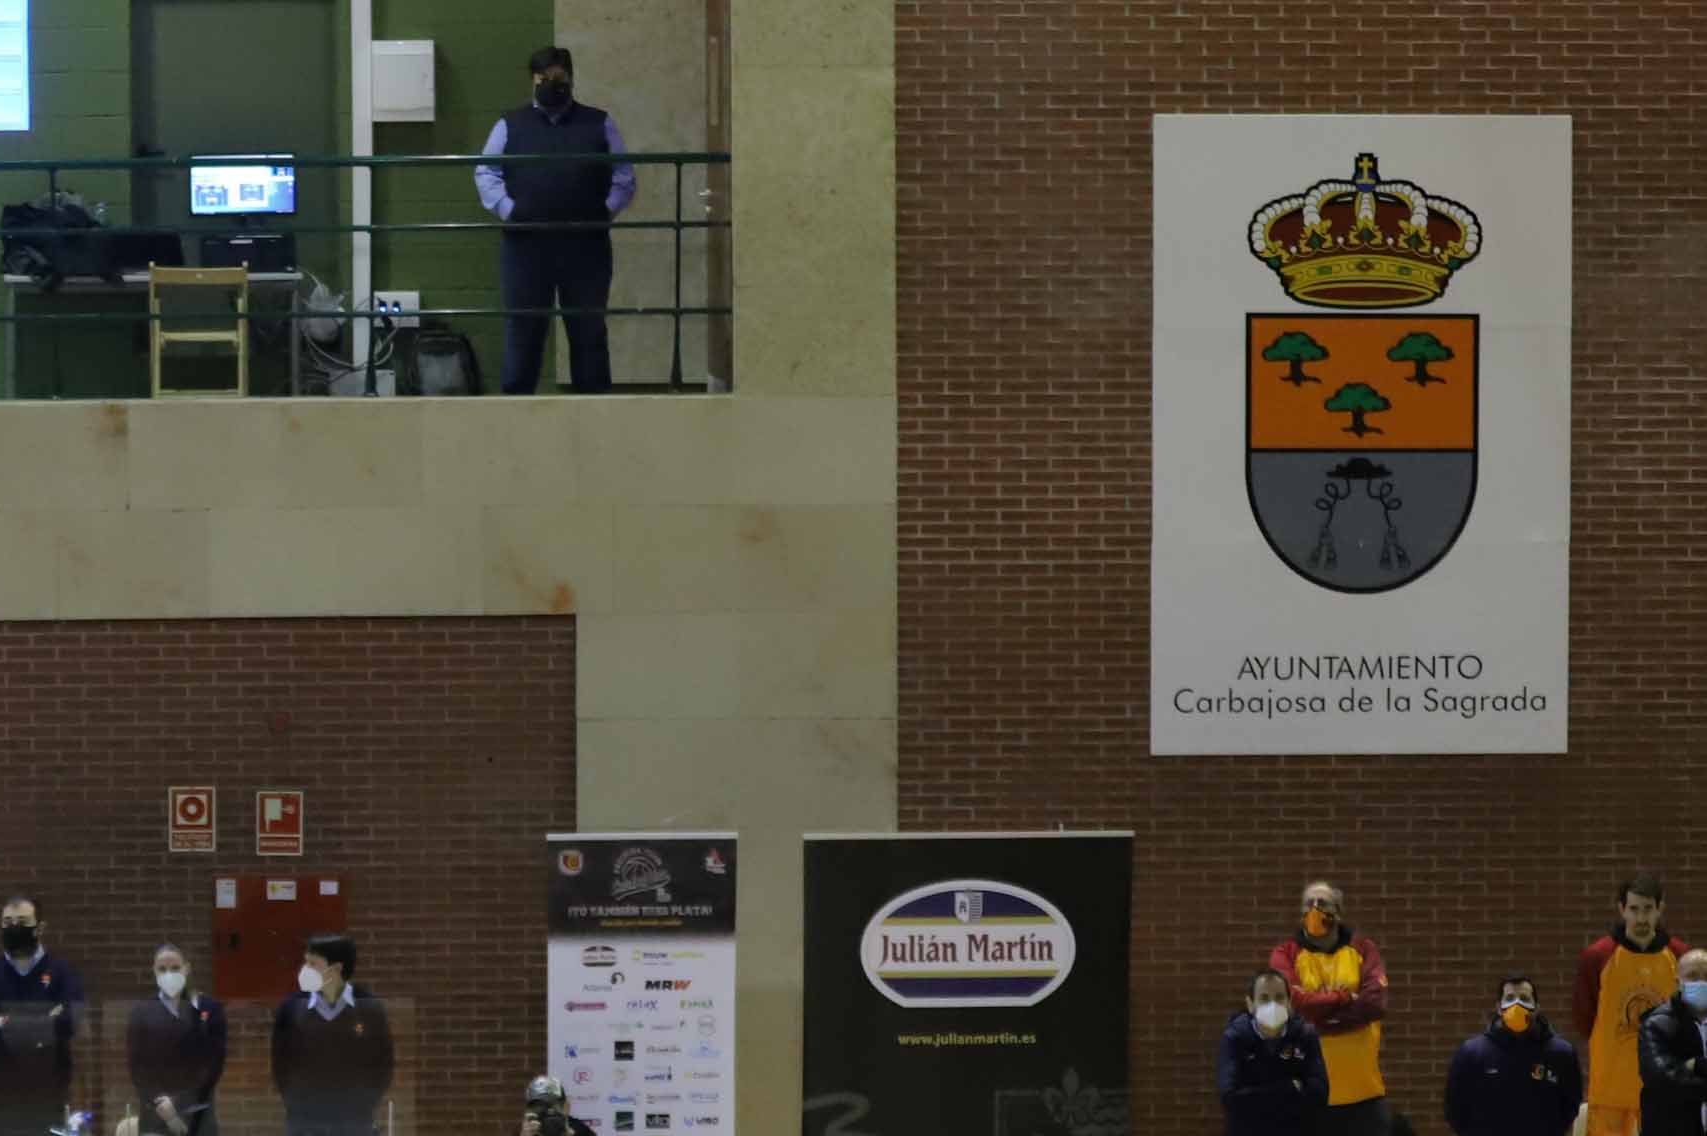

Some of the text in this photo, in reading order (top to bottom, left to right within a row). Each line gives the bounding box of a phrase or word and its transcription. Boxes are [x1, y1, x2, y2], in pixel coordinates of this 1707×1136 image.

[1237, 655, 1484, 681] AYUNTAMIENTO
[1173, 686, 1547, 719] Carbajosa de la Sagrada
[879, 932, 1054, 967] Julián Martín
[644, 979, 692, 991] MRW
[898, 1032, 1036, 1048] www.julianmartin.es
